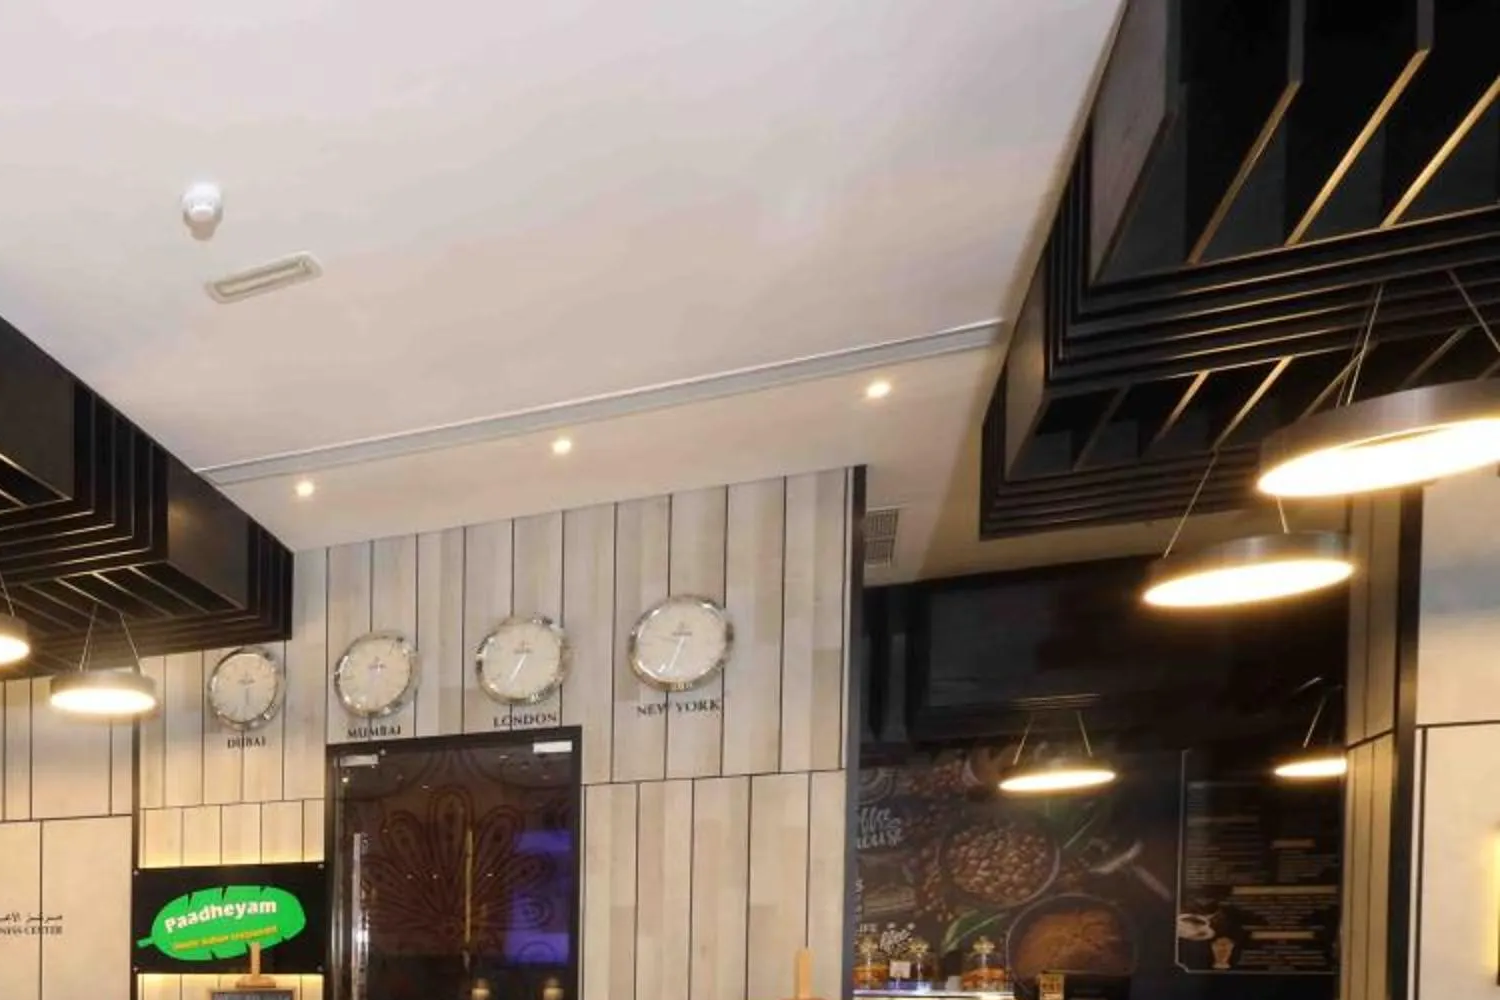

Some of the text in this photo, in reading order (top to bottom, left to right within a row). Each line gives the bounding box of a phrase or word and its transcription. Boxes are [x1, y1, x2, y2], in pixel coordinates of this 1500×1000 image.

[637, 699, 721, 716] NEW YORK
[492, 711, 558, 729] LONDON
[346, 725, 402, 739] MUMBAI
[226, 735, 267, 750] DUBAI
[163, 899, 278, 934] Paadheyam
[24, 925, 63, 935] CENTER
